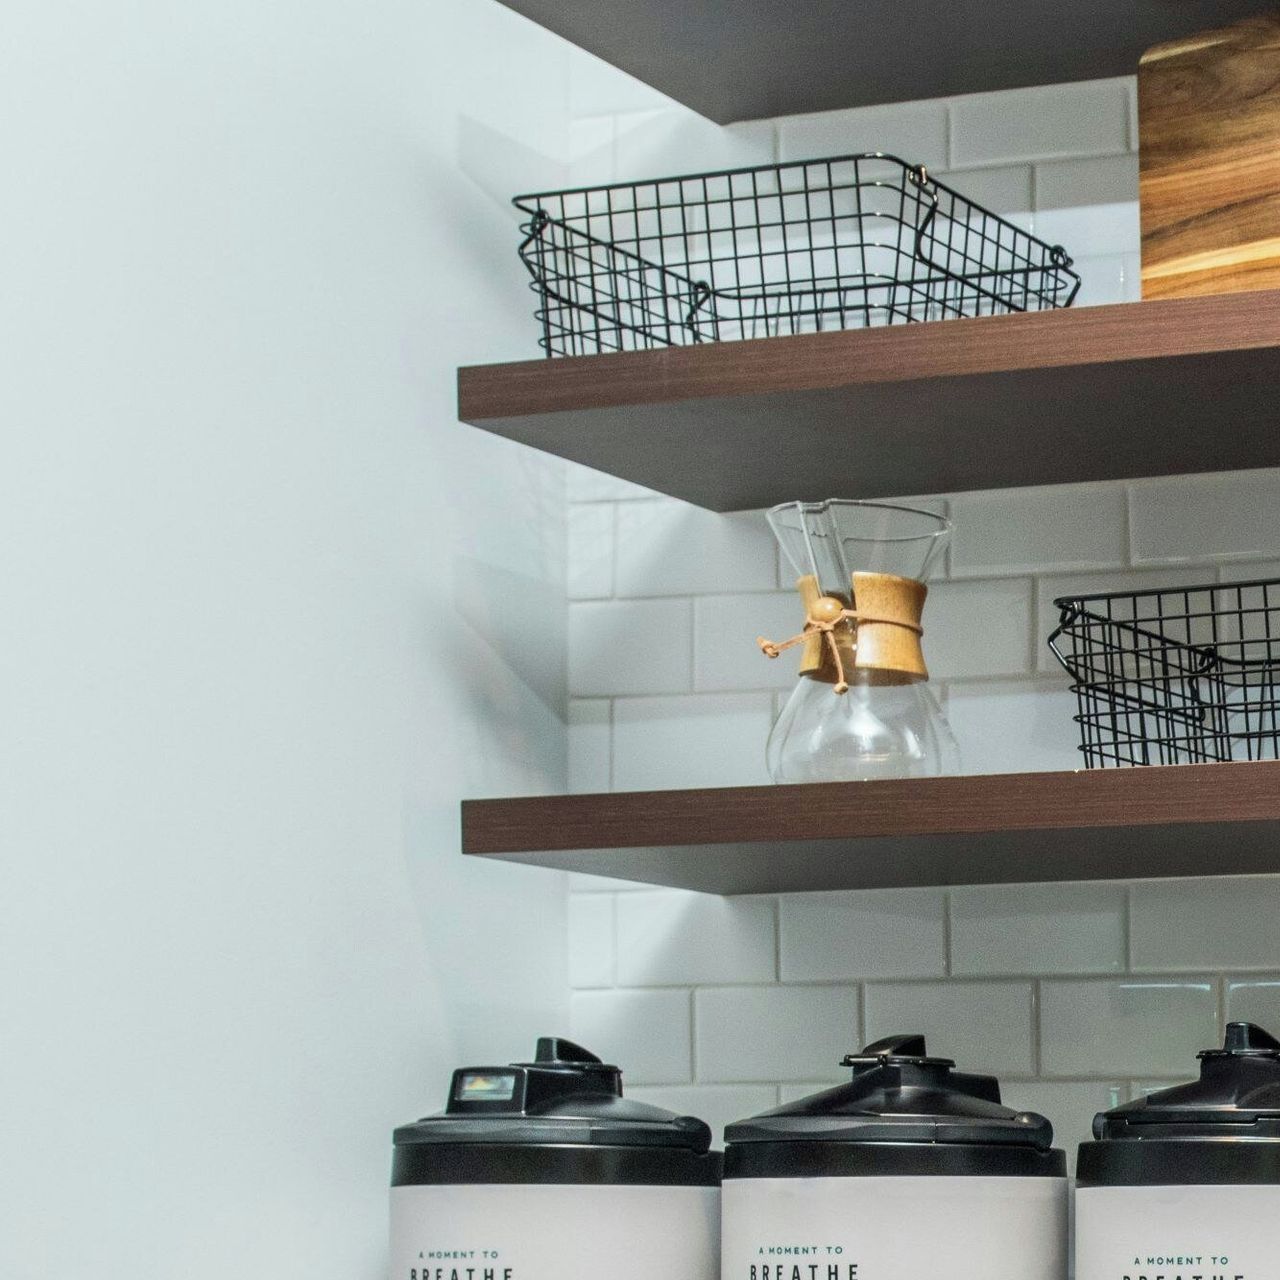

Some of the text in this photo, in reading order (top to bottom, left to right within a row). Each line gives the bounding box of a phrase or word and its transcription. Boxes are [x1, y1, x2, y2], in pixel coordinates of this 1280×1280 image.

[428, 1251, 475, 1259] MOMENT
[483, 1251, 499, 1259] TO
[758, 1246, 843, 1255] A MOMENT TO
[1134, 1256, 1229, 1266] A MOMENT TO
